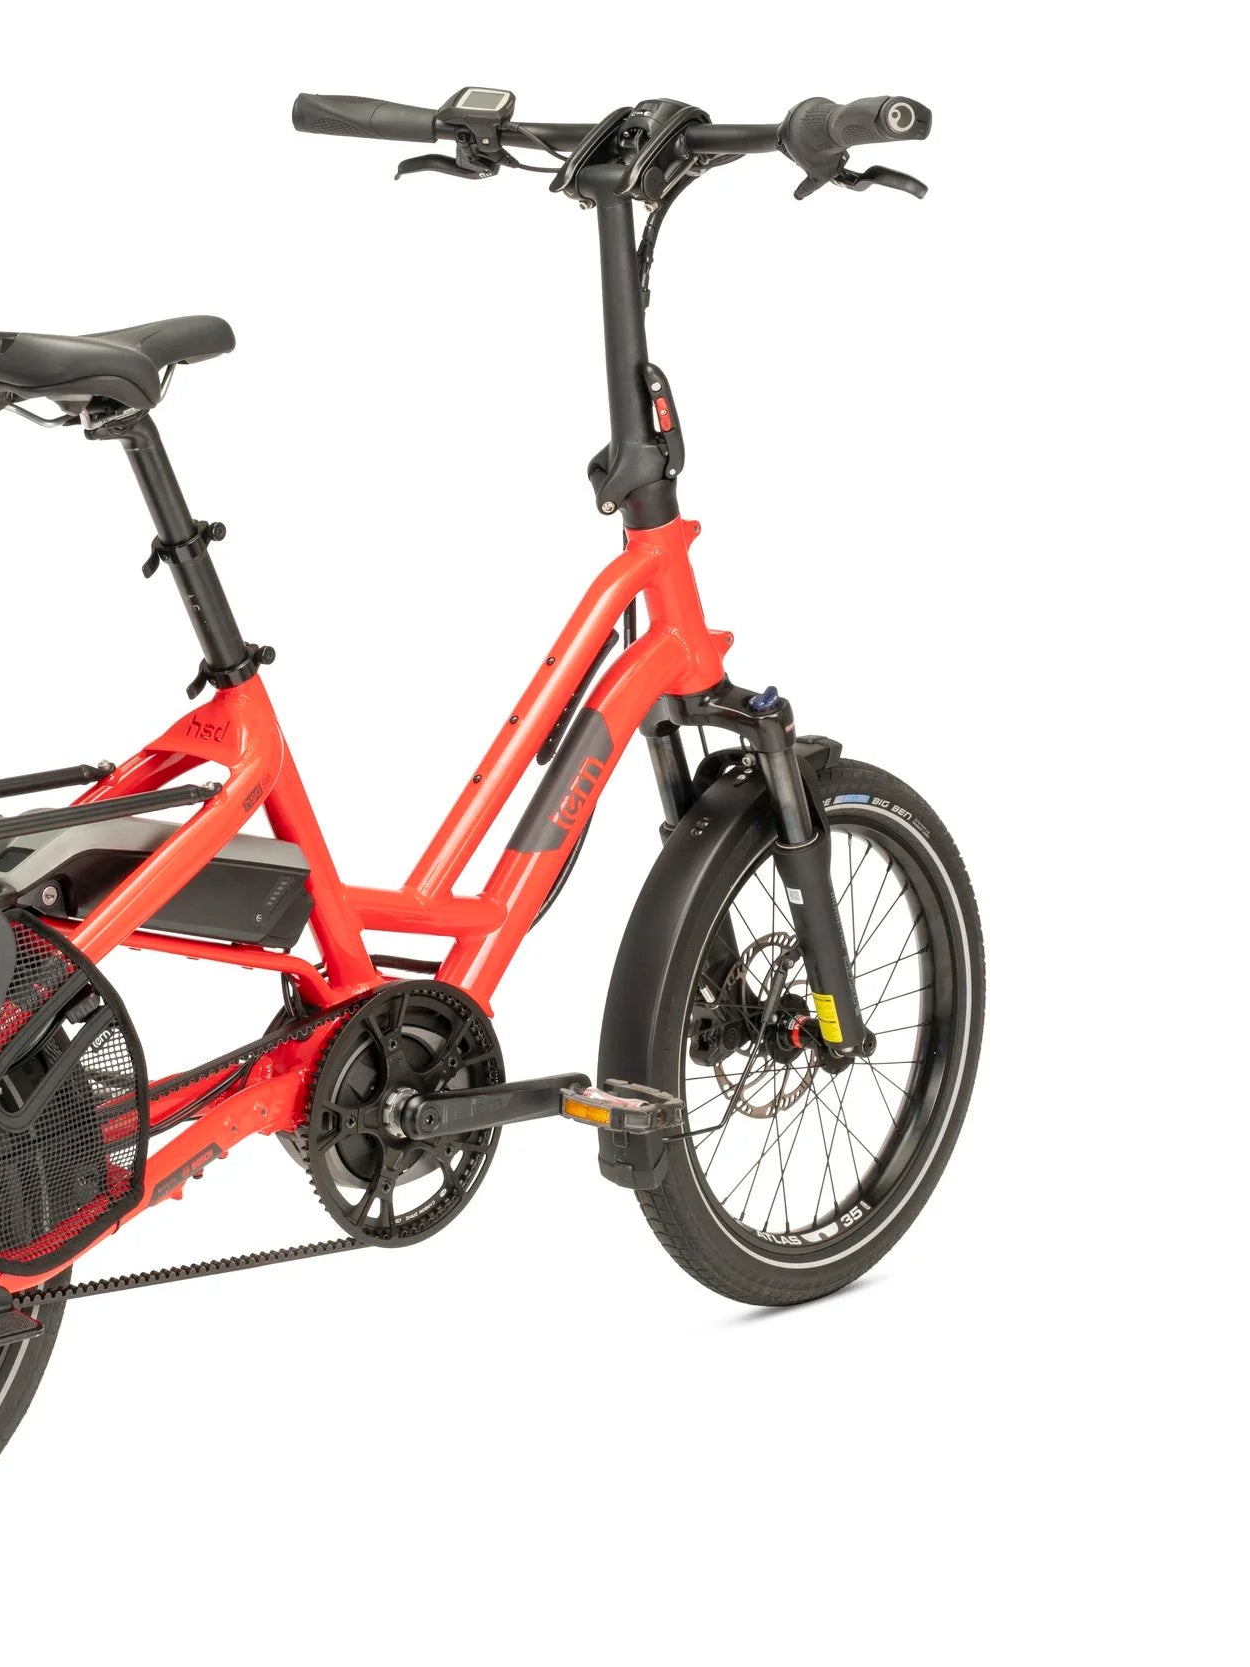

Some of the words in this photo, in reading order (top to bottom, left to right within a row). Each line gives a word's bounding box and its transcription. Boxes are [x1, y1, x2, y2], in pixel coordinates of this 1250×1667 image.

[186, 715, 230, 743] hsd
[548, 756, 606, 832] tern
[872, 797, 891, 809] BIG
[891, 804, 913, 821] BEN
[92, 1029, 111, 1049] tern
[191, 1148, 214, 1171] BOSCH
[756, 1229, 802, 1246] ATLAS
[840, 1205, 863, 1228] 35
